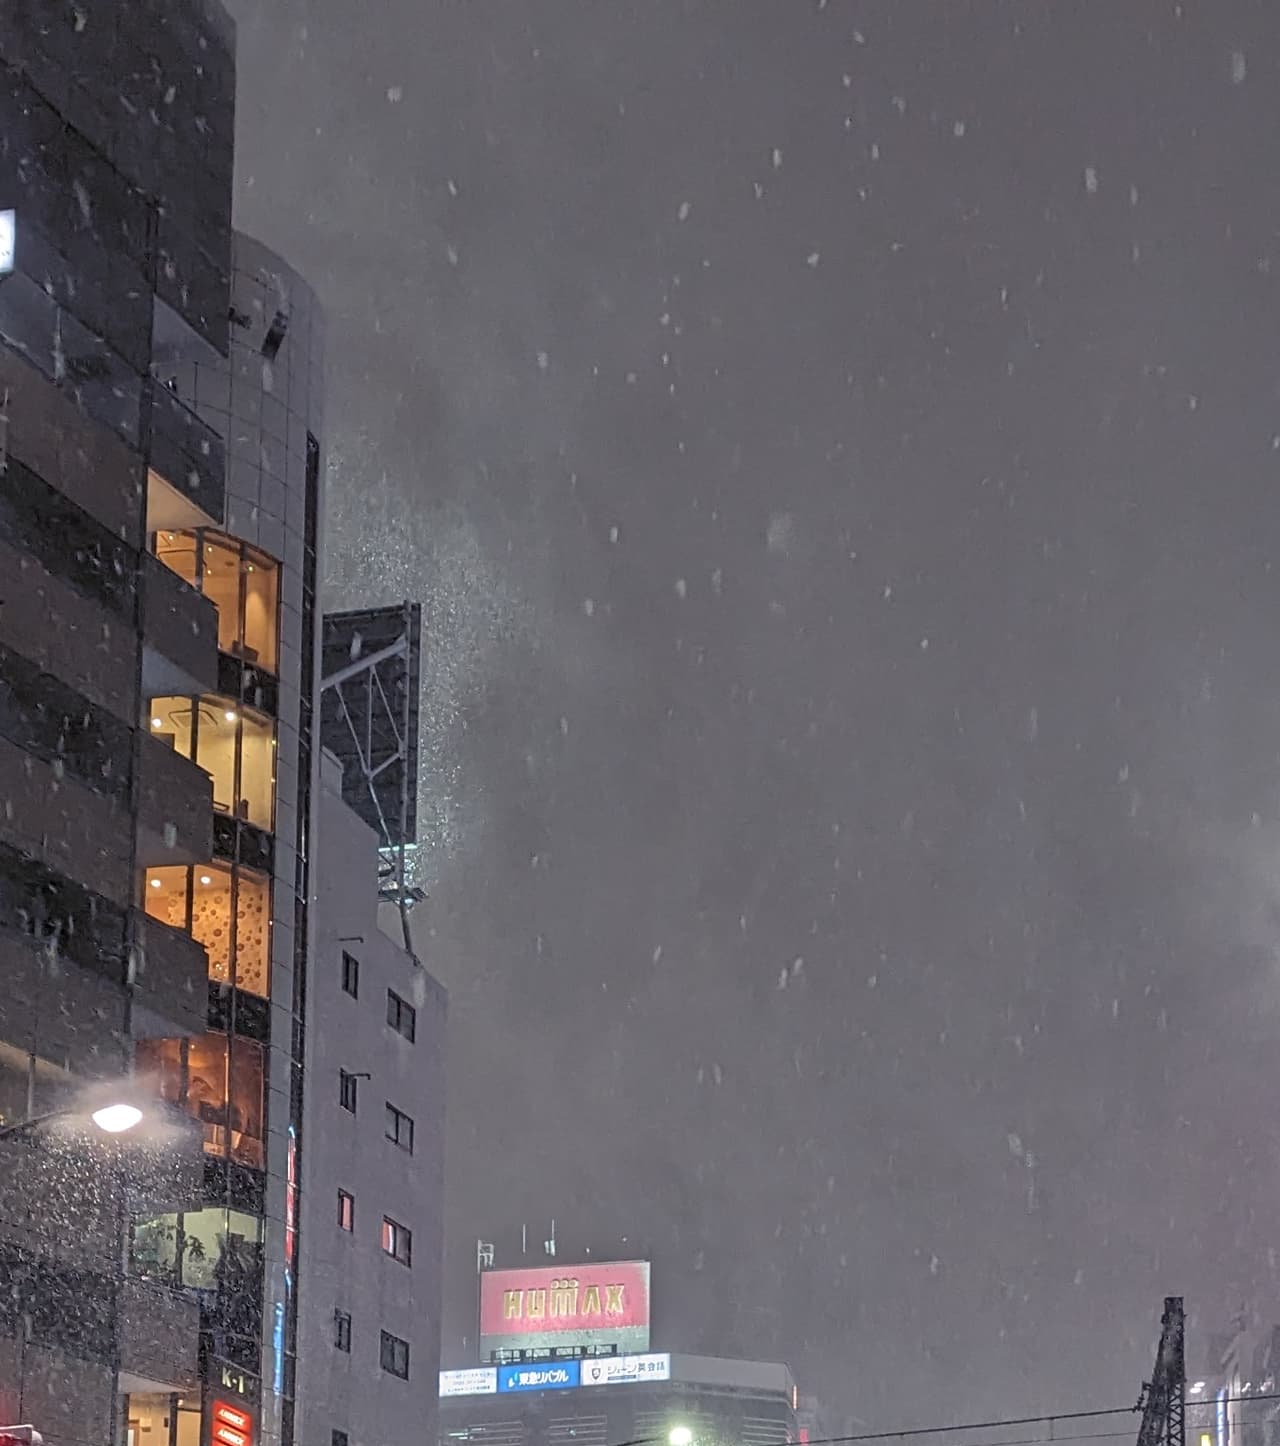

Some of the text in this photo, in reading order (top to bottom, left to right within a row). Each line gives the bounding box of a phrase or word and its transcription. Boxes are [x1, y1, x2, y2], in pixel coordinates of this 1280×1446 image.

[504, 1277, 625, 1320] HUMAX
[519, 1370, 569, 1386] 東急リバブル
